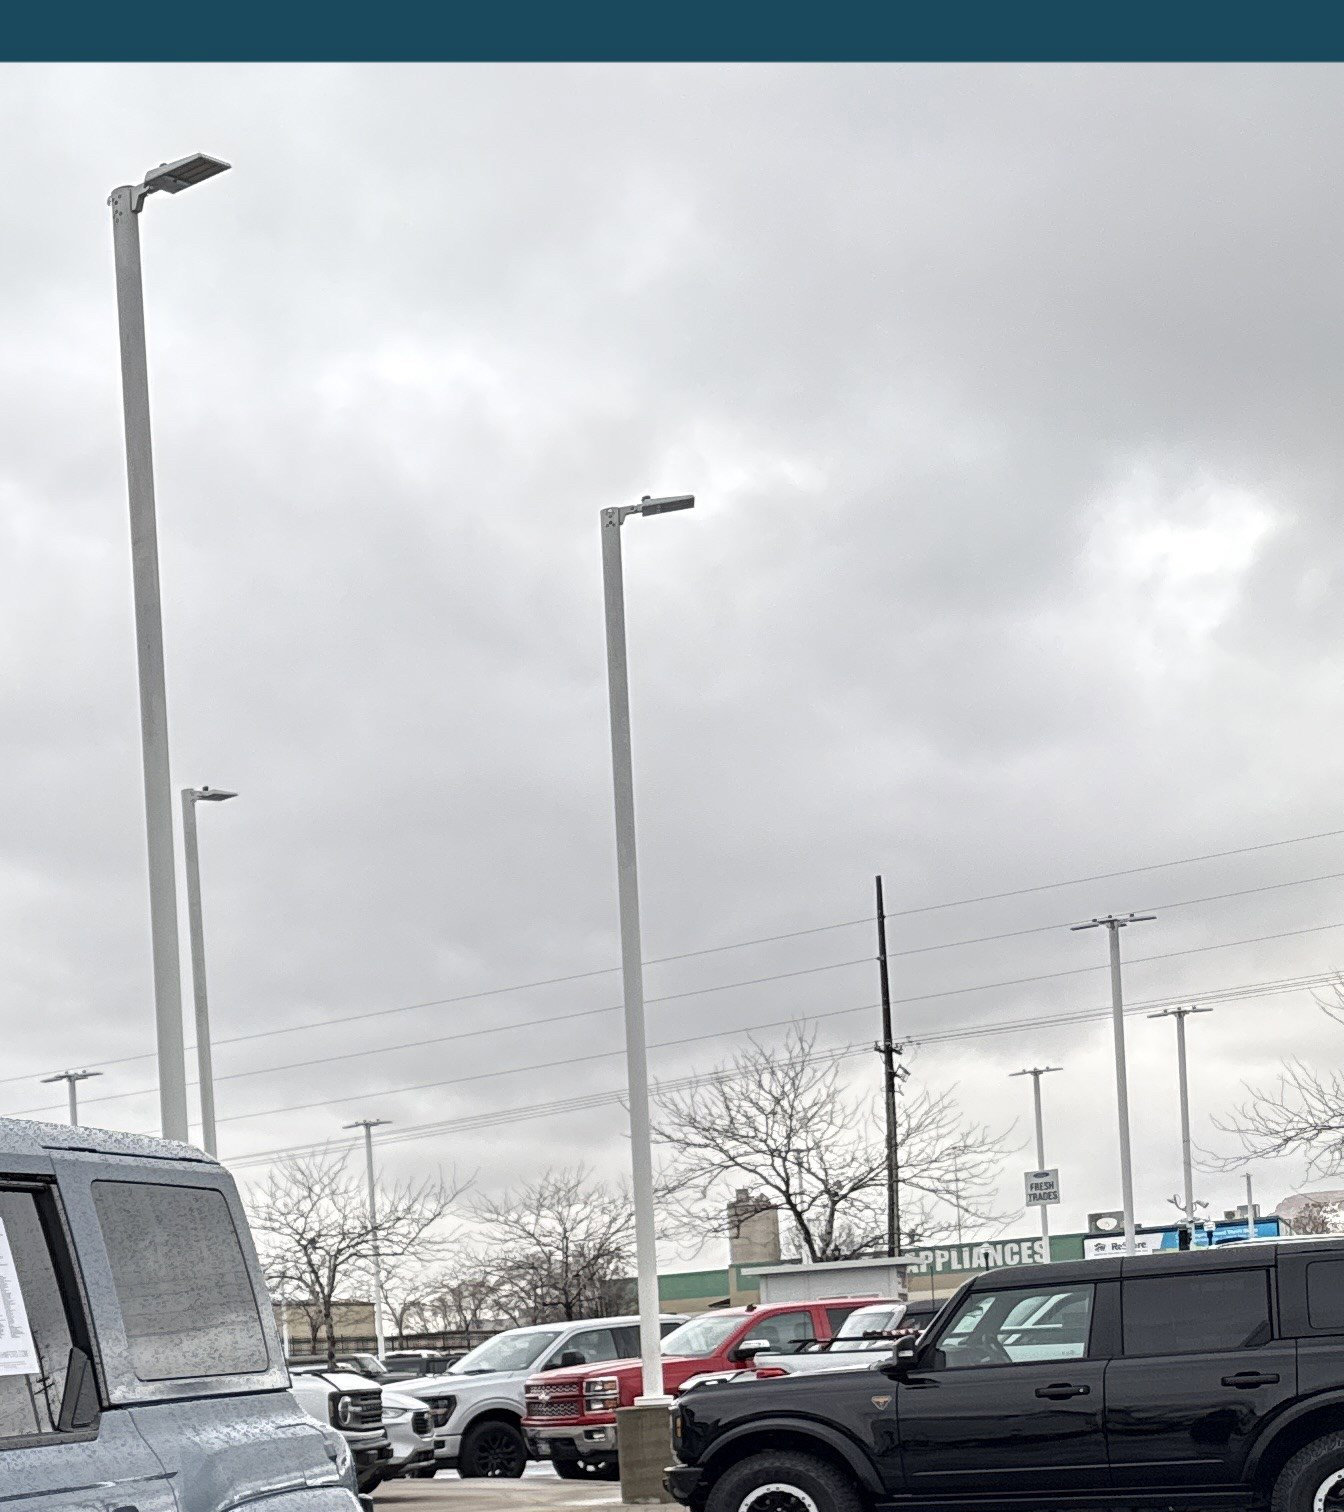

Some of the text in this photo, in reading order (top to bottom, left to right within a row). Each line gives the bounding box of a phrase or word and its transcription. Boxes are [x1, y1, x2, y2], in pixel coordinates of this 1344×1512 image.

[1029, 1181, 1055, 1192] FRESH
[1027, 1190, 1059, 1203] TRADES
[903, 1239, 1048, 1274] APPLIANCES
